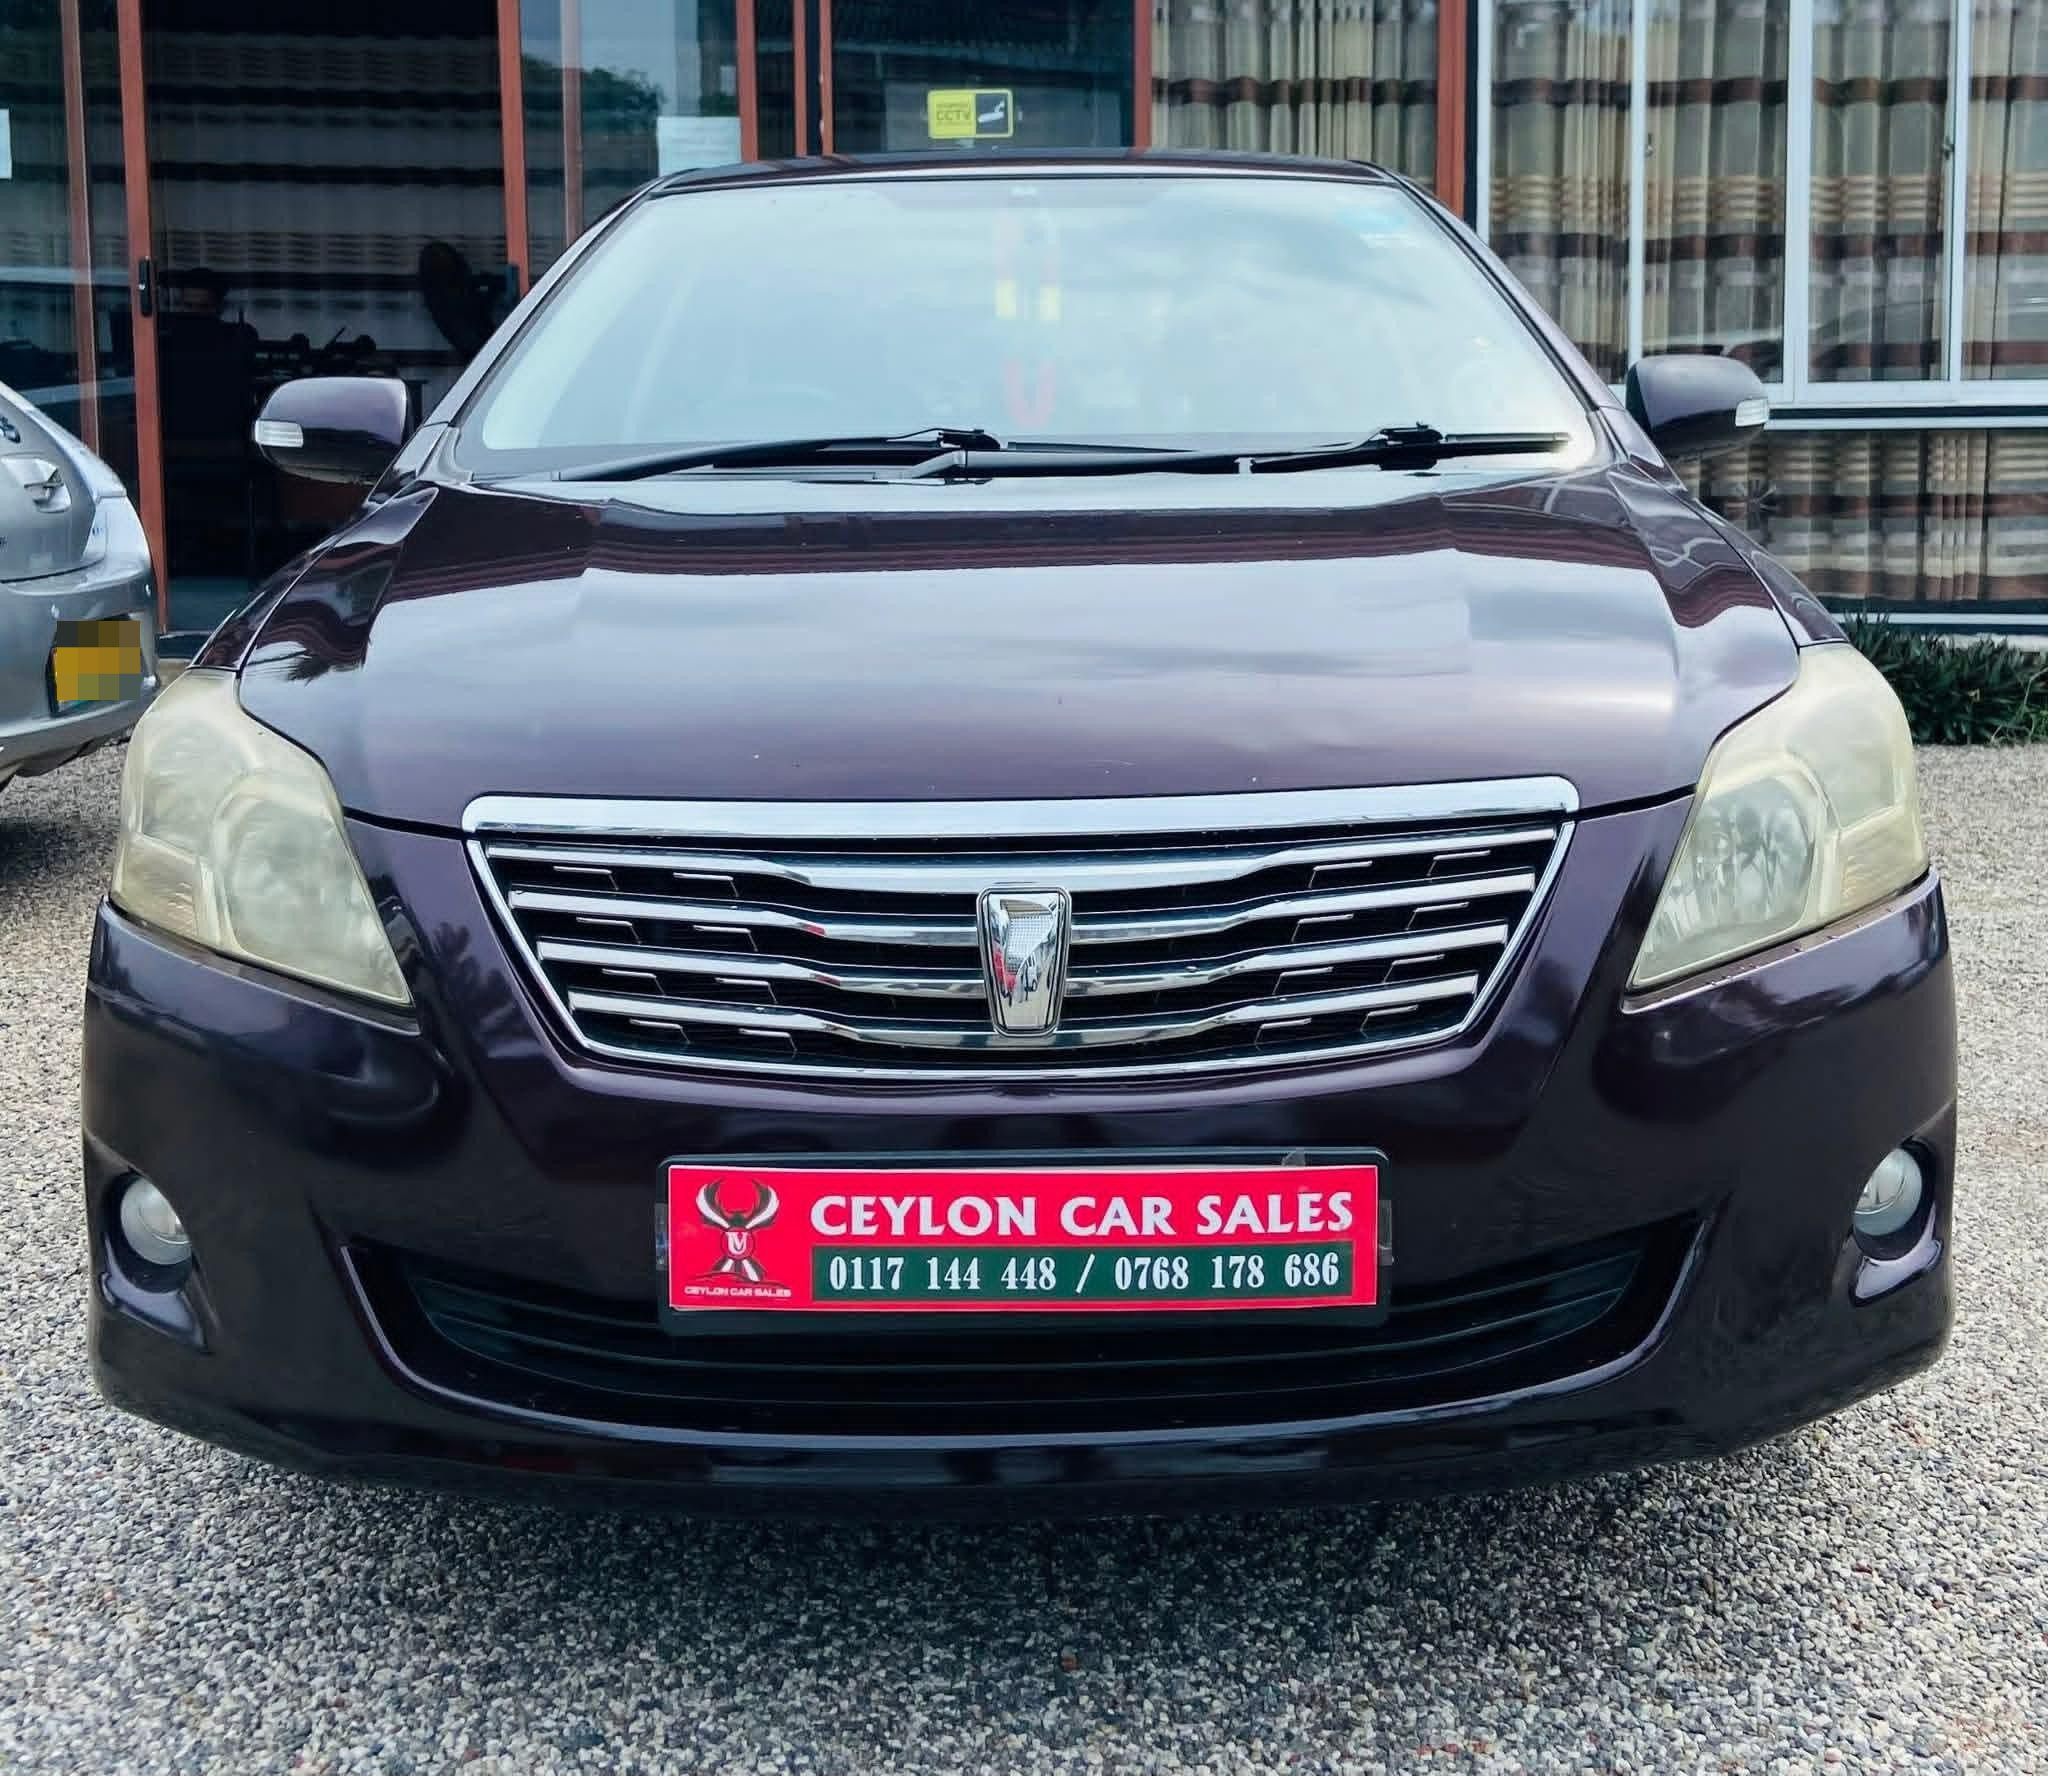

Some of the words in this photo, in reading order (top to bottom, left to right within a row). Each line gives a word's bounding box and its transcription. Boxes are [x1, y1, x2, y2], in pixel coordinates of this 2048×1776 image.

[810, 1195, 1036, 1236] CEYLON
[1060, 1196, 1176, 1236] CAR
[1196, 1191, 1352, 1235] SALES
[730, 1287, 753, 1297] CAR
[829, 1256, 904, 1290] 0117
[927, 1257, 980, 1290] 144
[1001, 1257, 1056, 1290] 448
[1075, 1254, 1095, 1294] /
[1114, 1256, 1189, 1290] 0768
[1211, 1254, 1265, 1289] 178
[1284, 1252, 1339, 1287] 686
